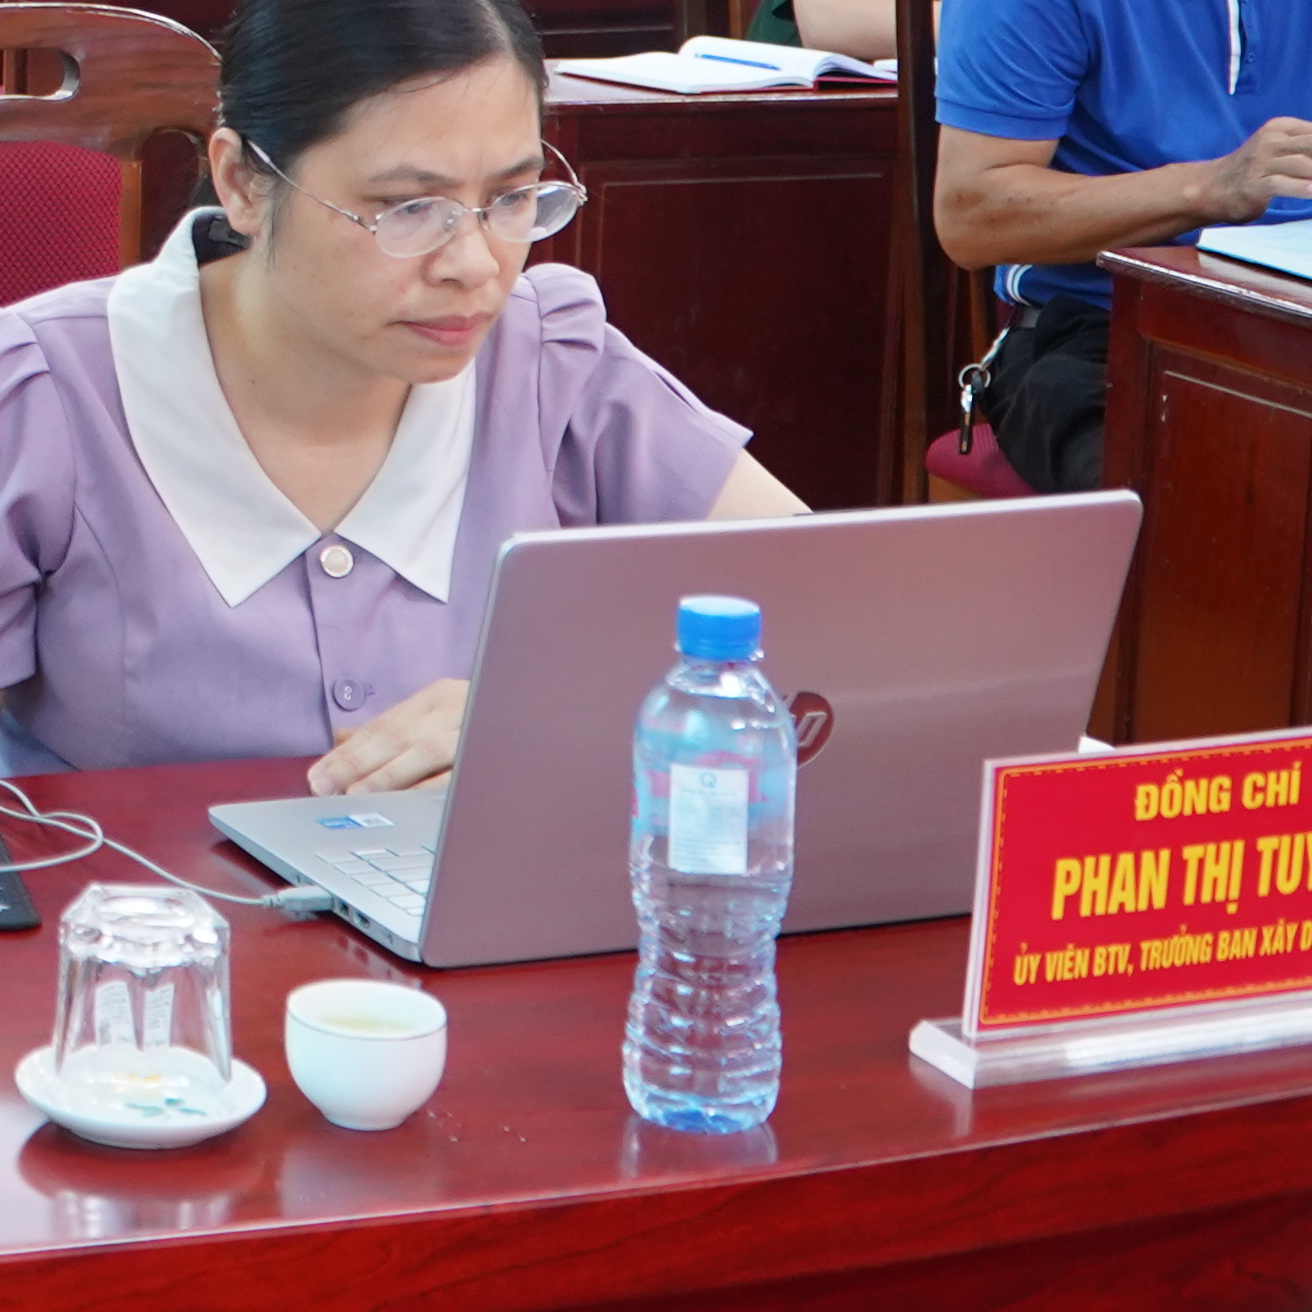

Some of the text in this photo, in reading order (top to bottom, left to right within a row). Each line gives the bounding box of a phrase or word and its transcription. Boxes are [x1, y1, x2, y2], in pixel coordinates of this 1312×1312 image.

[1135, 761, 1302, 821] ĐỒNG CHÍ
[1051, 831, 1312, 920] PHAN THỊ TU
[1013, 942, 1042, 986] ỦY
[1045, 942, 1090, 983] VIÊN
[1092, 943, 1134, 977] BTV,
[1216, 927, 1258, 962] BAN
[1259, 917, 1299, 957] XÂY
